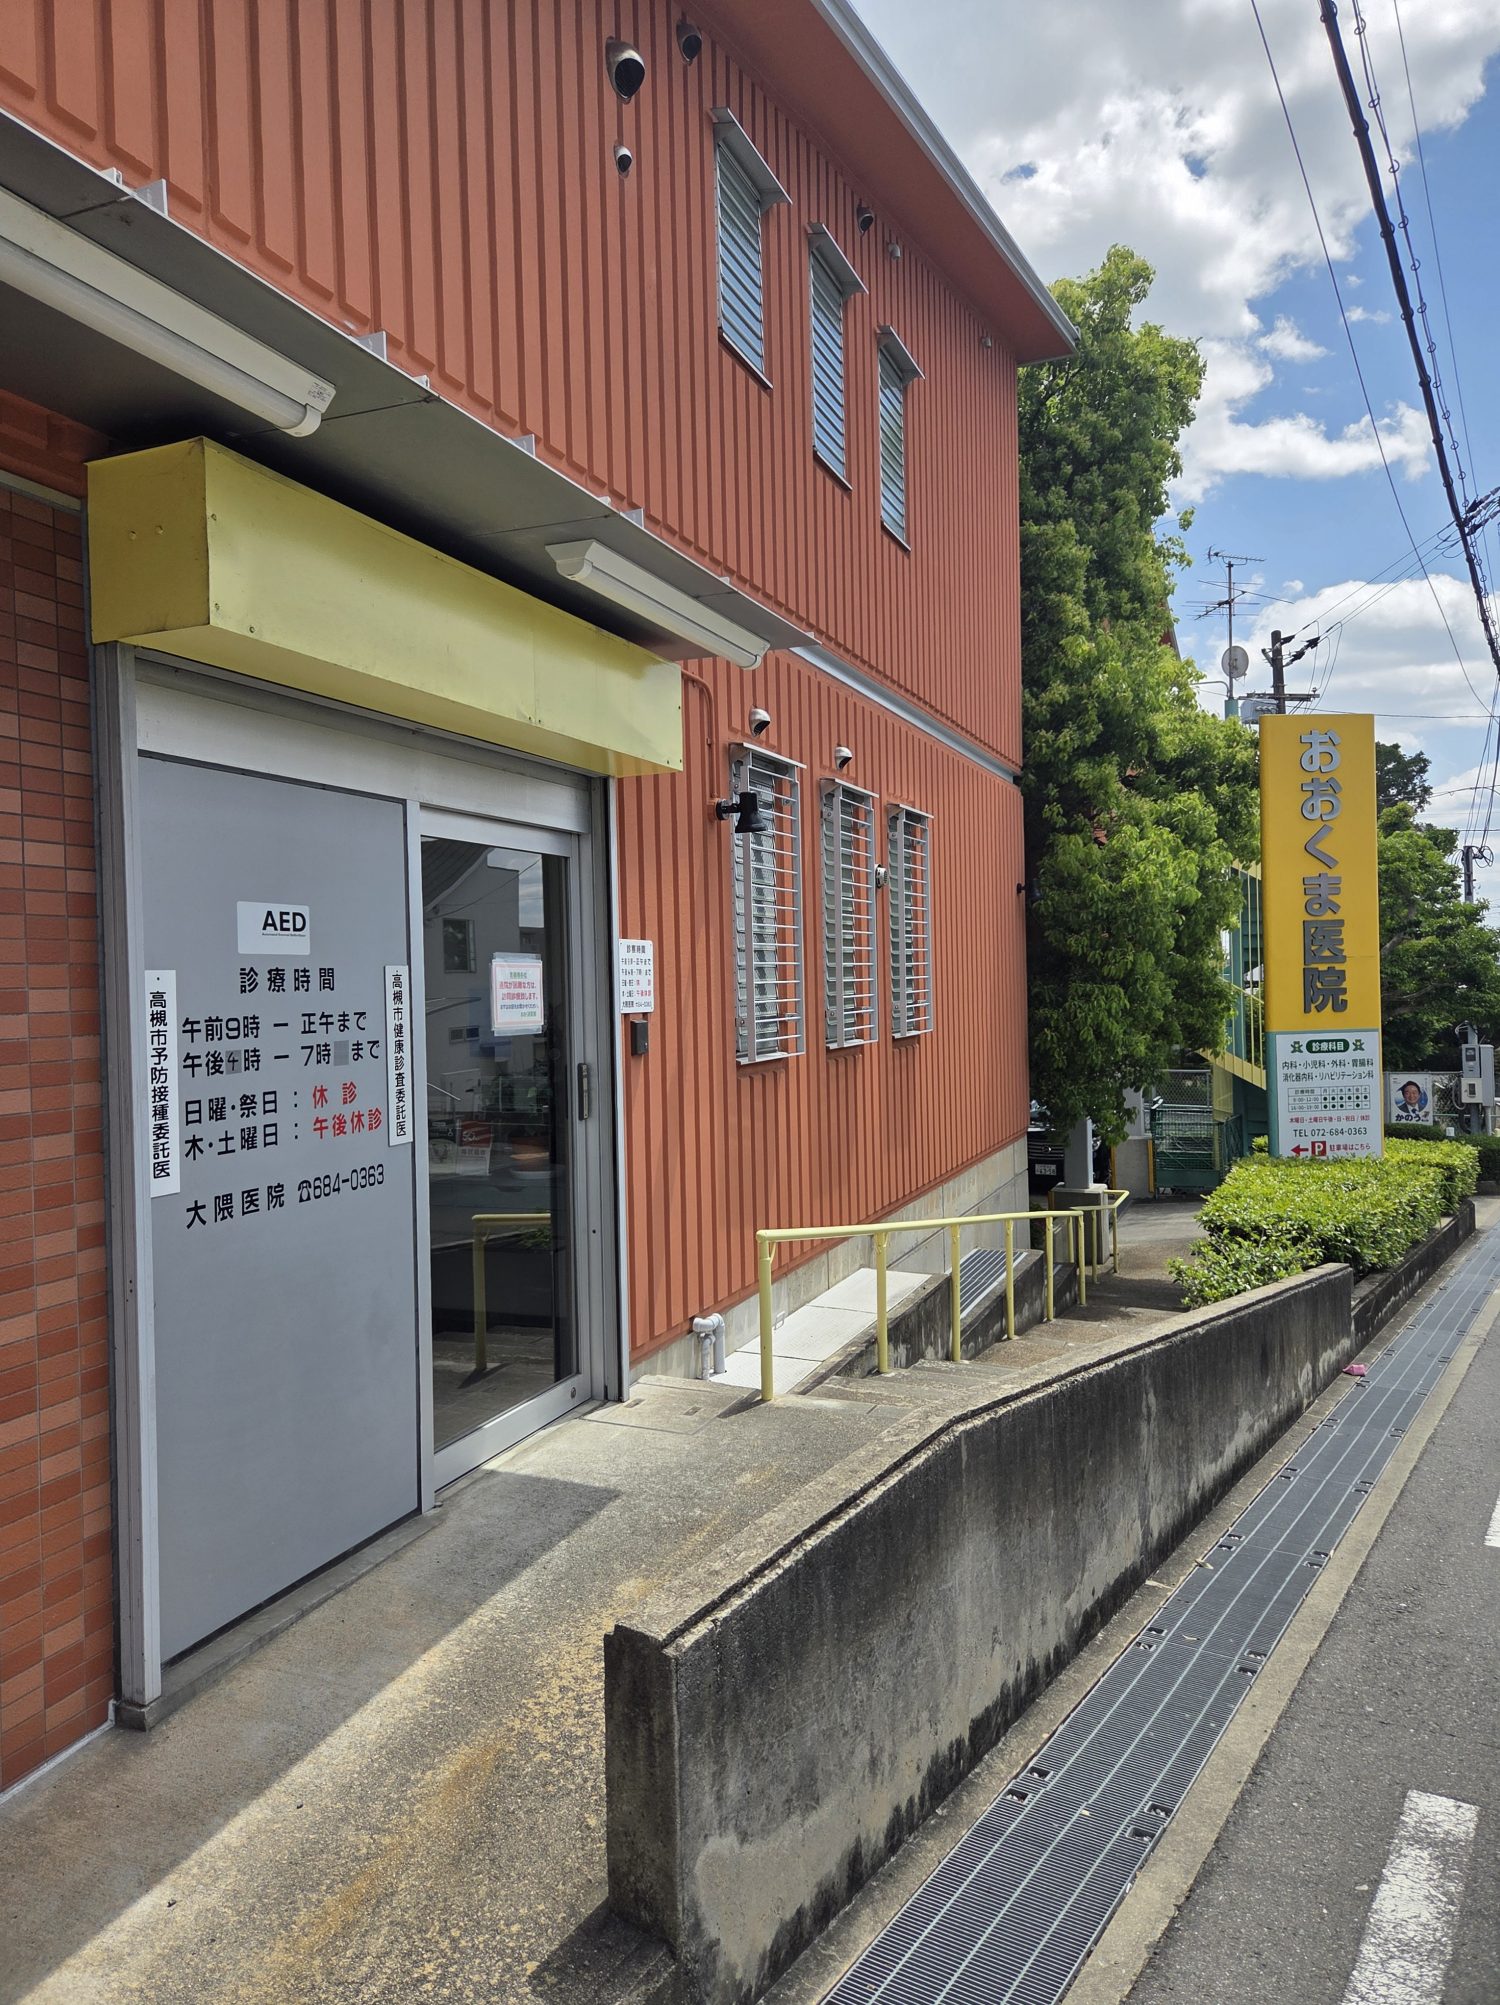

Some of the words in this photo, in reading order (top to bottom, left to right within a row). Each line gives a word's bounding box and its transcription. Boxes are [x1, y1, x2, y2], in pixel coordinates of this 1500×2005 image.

[1300, 728, 1348, 1014] おおくま医院
[262, 910, 306, 932] AED
[239, 967, 335, 994] 診療時間
[301, 1011, 367, 1035] 正午まで
[149, 991, 171, 1179] 高槻市予防接種委託医
[312, 1108, 383, 1140] 午後休診
[1293, 1129, 1308, 1137] TEL
[1310, 1127, 1367, 1137] 072-684-0363
[186, 1182, 285, 1229] 大隈医院
